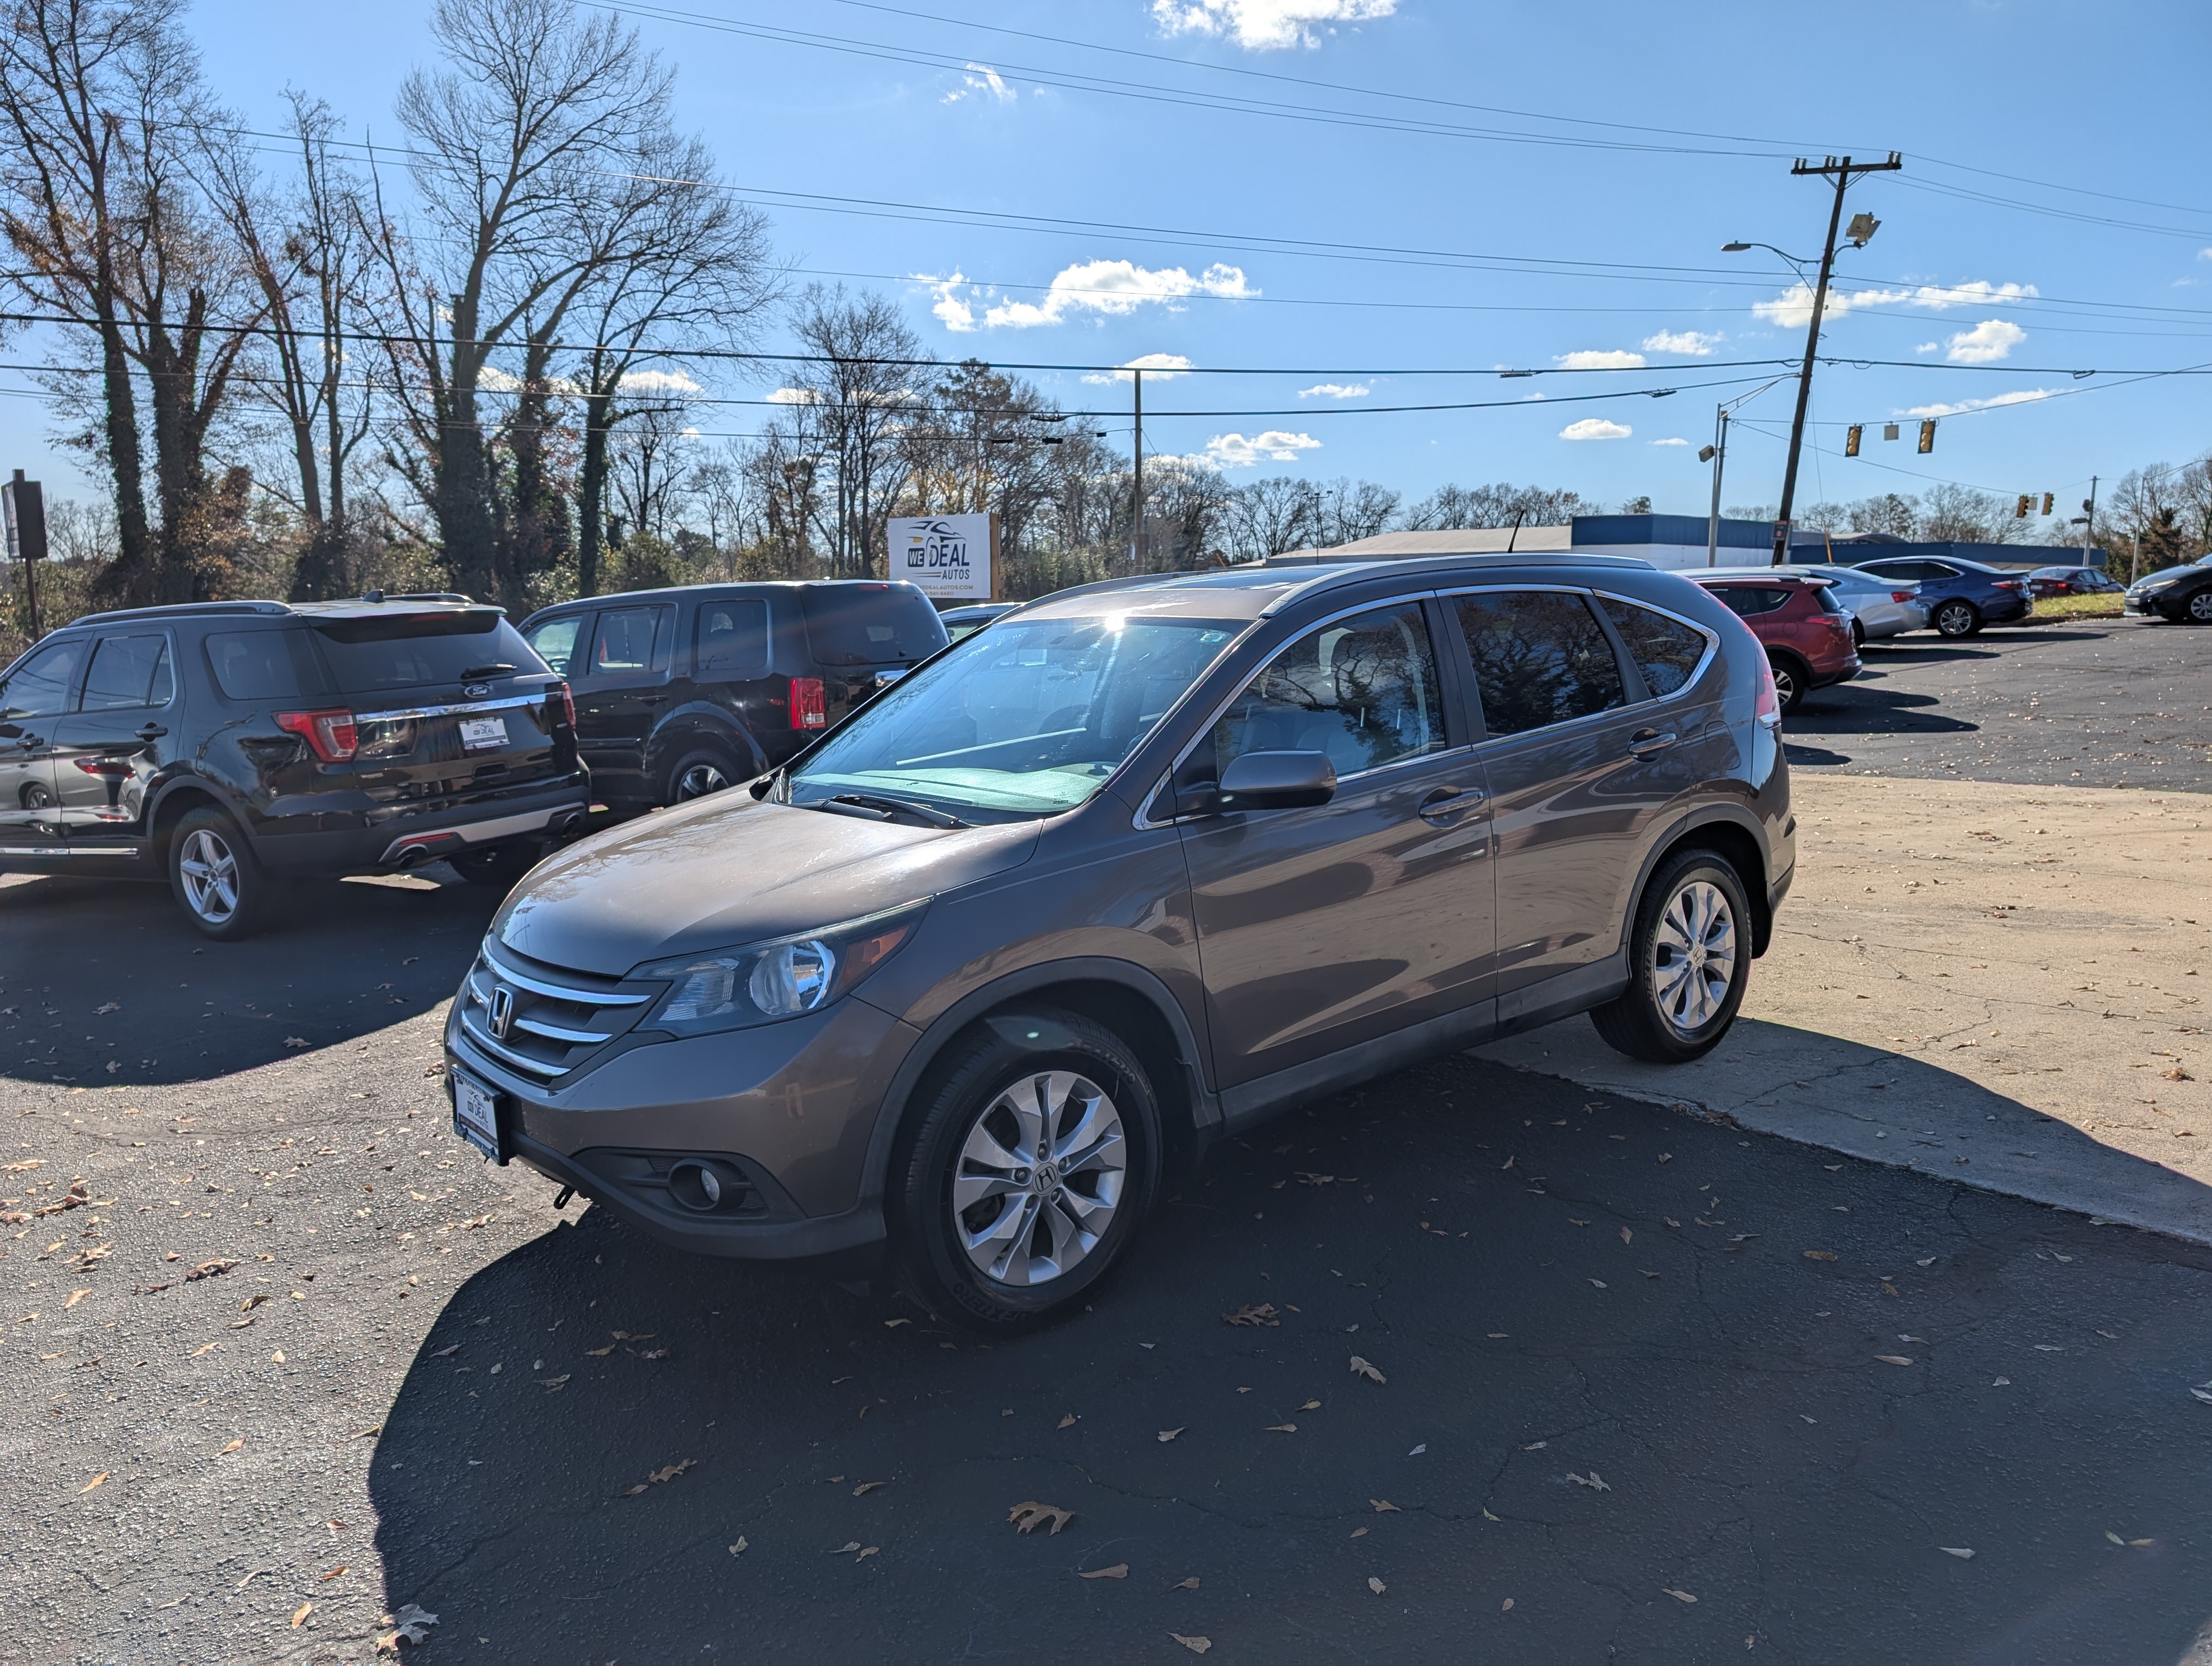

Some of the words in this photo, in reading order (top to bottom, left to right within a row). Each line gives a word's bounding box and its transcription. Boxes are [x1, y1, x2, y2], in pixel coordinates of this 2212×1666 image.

[909, 550, 923, 565] WE
[929, 543, 970, 567] DEAL
[942, 569, 970, 580] AUTOS
[472, 686, 488, 696] Ford
[474, 1103, 488, 1124] DEAL
